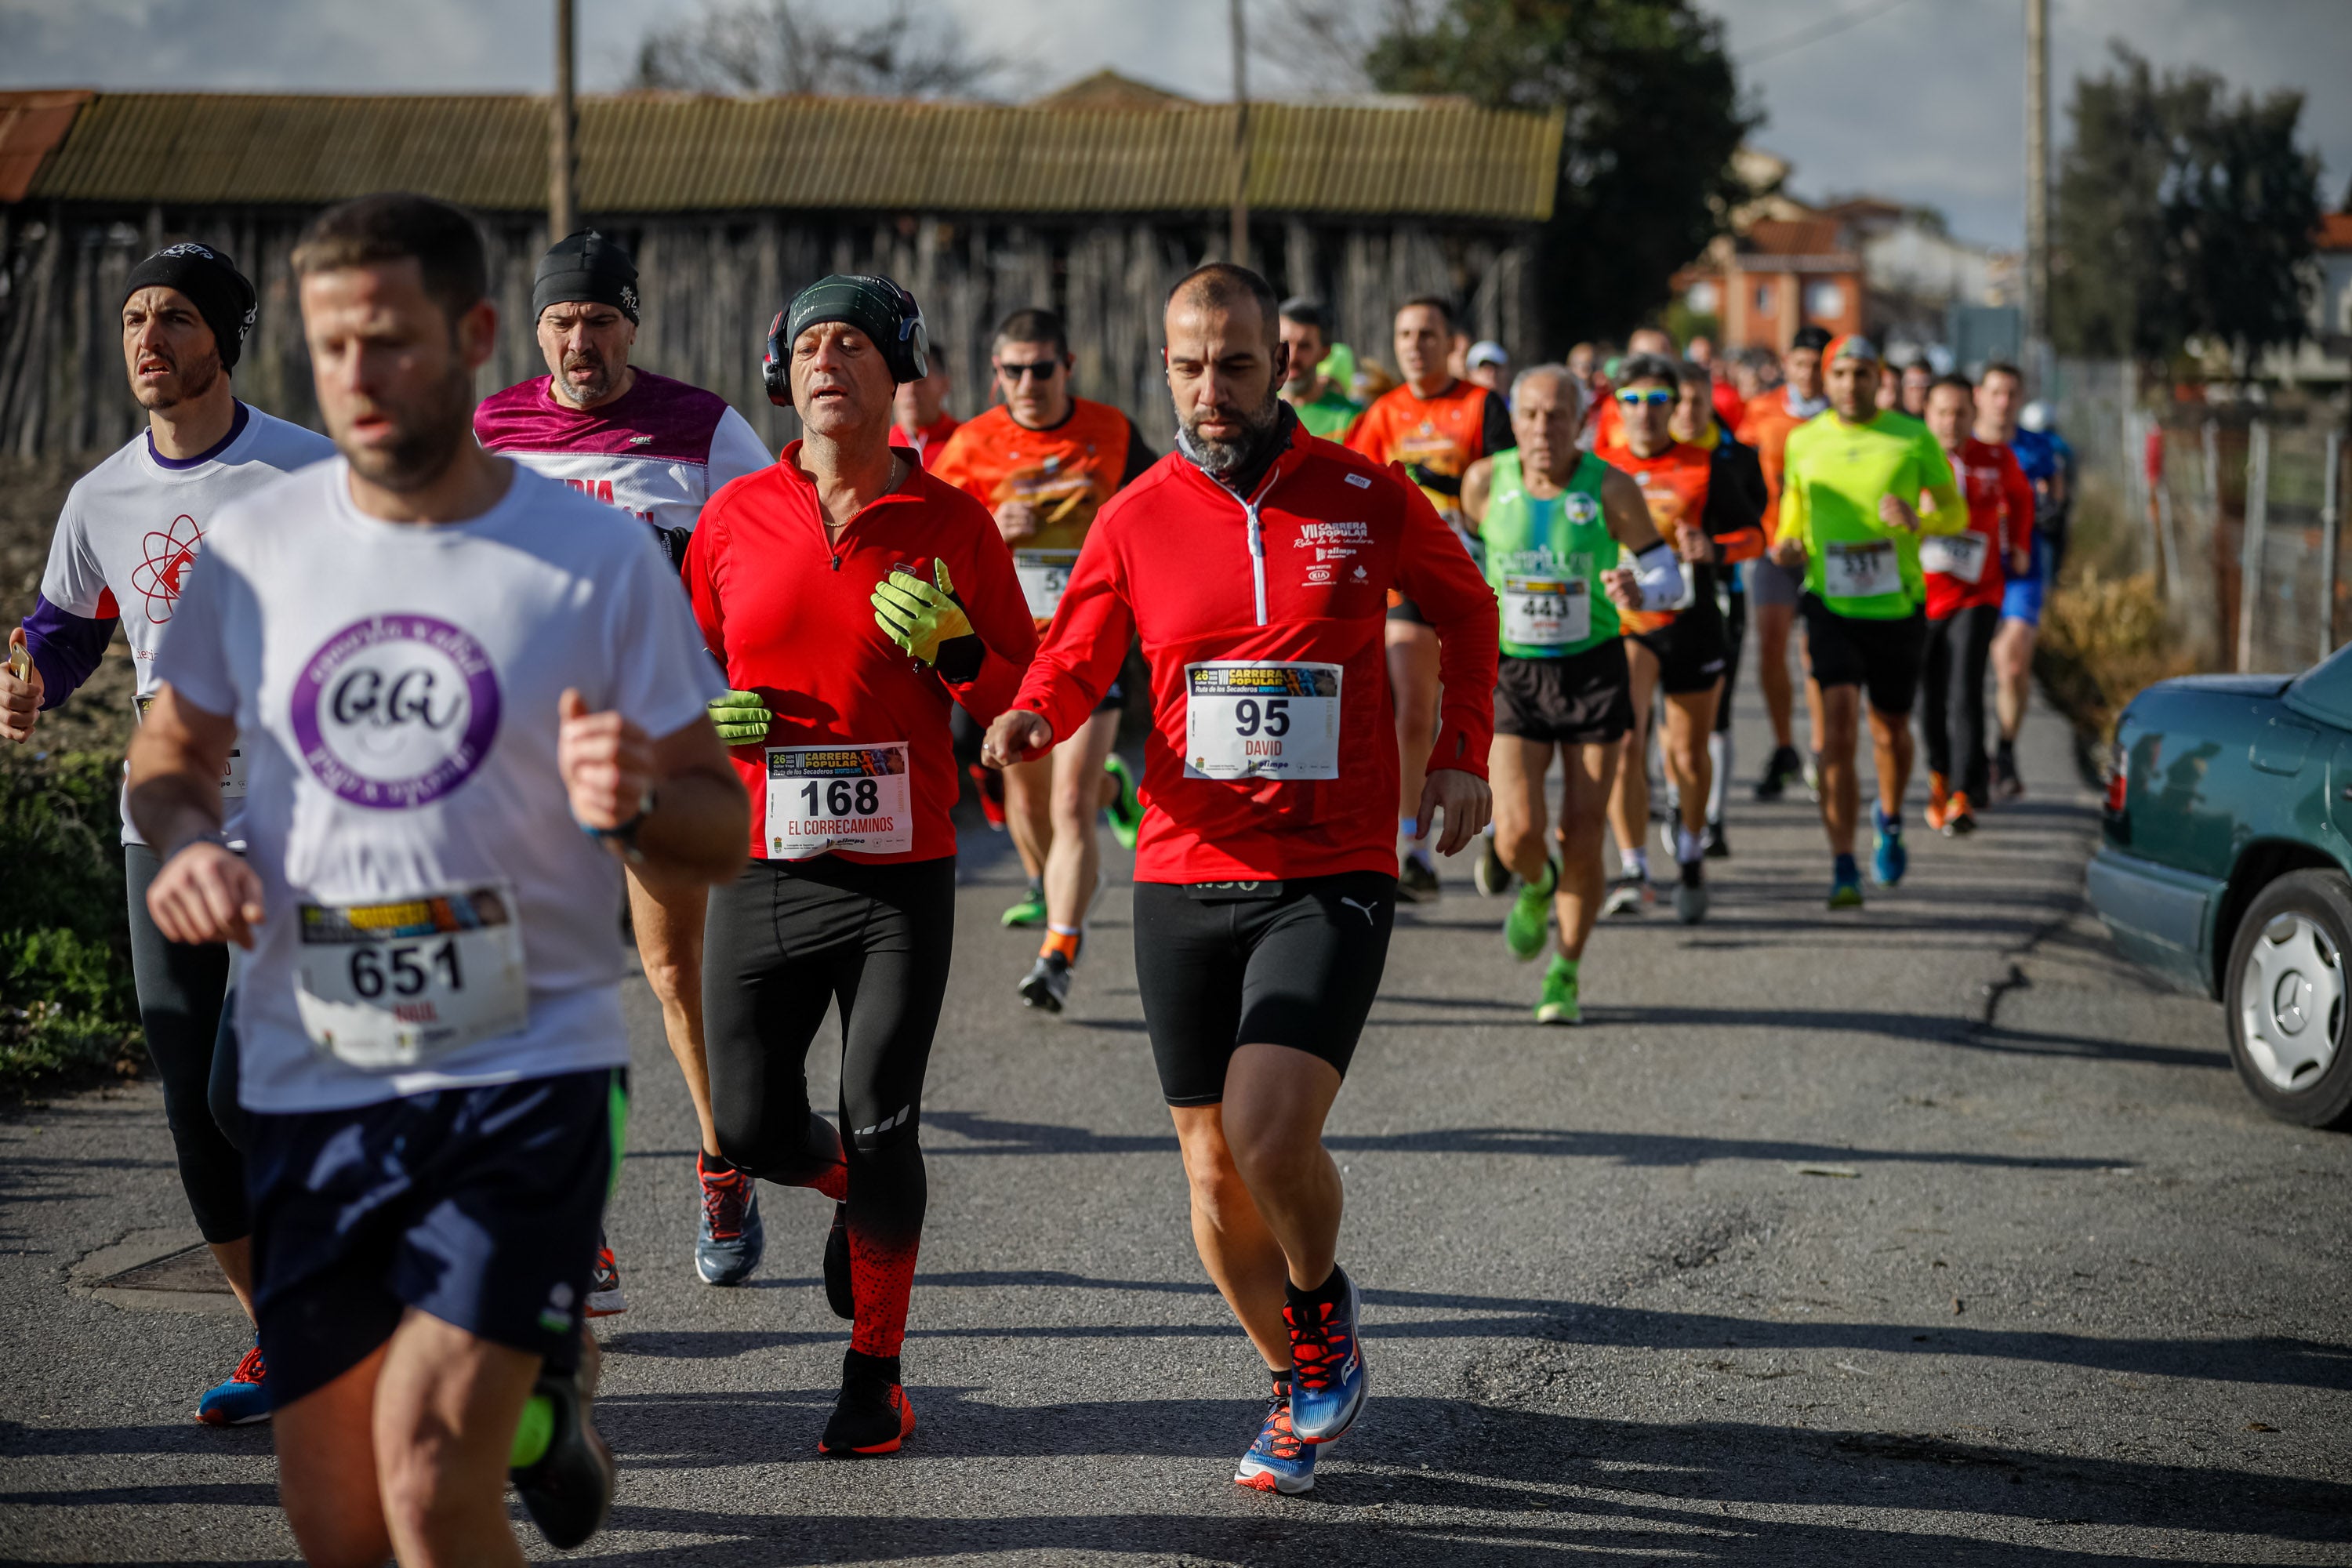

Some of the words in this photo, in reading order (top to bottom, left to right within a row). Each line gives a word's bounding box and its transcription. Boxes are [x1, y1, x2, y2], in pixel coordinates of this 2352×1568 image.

[1301, 524, 1318, 539] VII
[1293, 539, 1315, 548] Ruta
[1327, 546, 1357, 555] olimpo
[1523, 597, 1569, 619] 443
[1195, 670, 1208, 681] 26
[1218, 670, 1229, 685] VII
[1236, 699, 1290, 737] 95
[1245, 740, 1282, 757] DAVID
[773, 755, 786, 764] 26
[795, 753, 805, 768] VII
[805, 752, 858, 760] CARRERA
[1259, 760, 1288, 770] olimpo
[800, 779, 880, 817] 168
[789, 820, 801, 836] EL
[804, 817, 894, 836] CORRECAMINOS
[350, 938, 463, 999] 651
